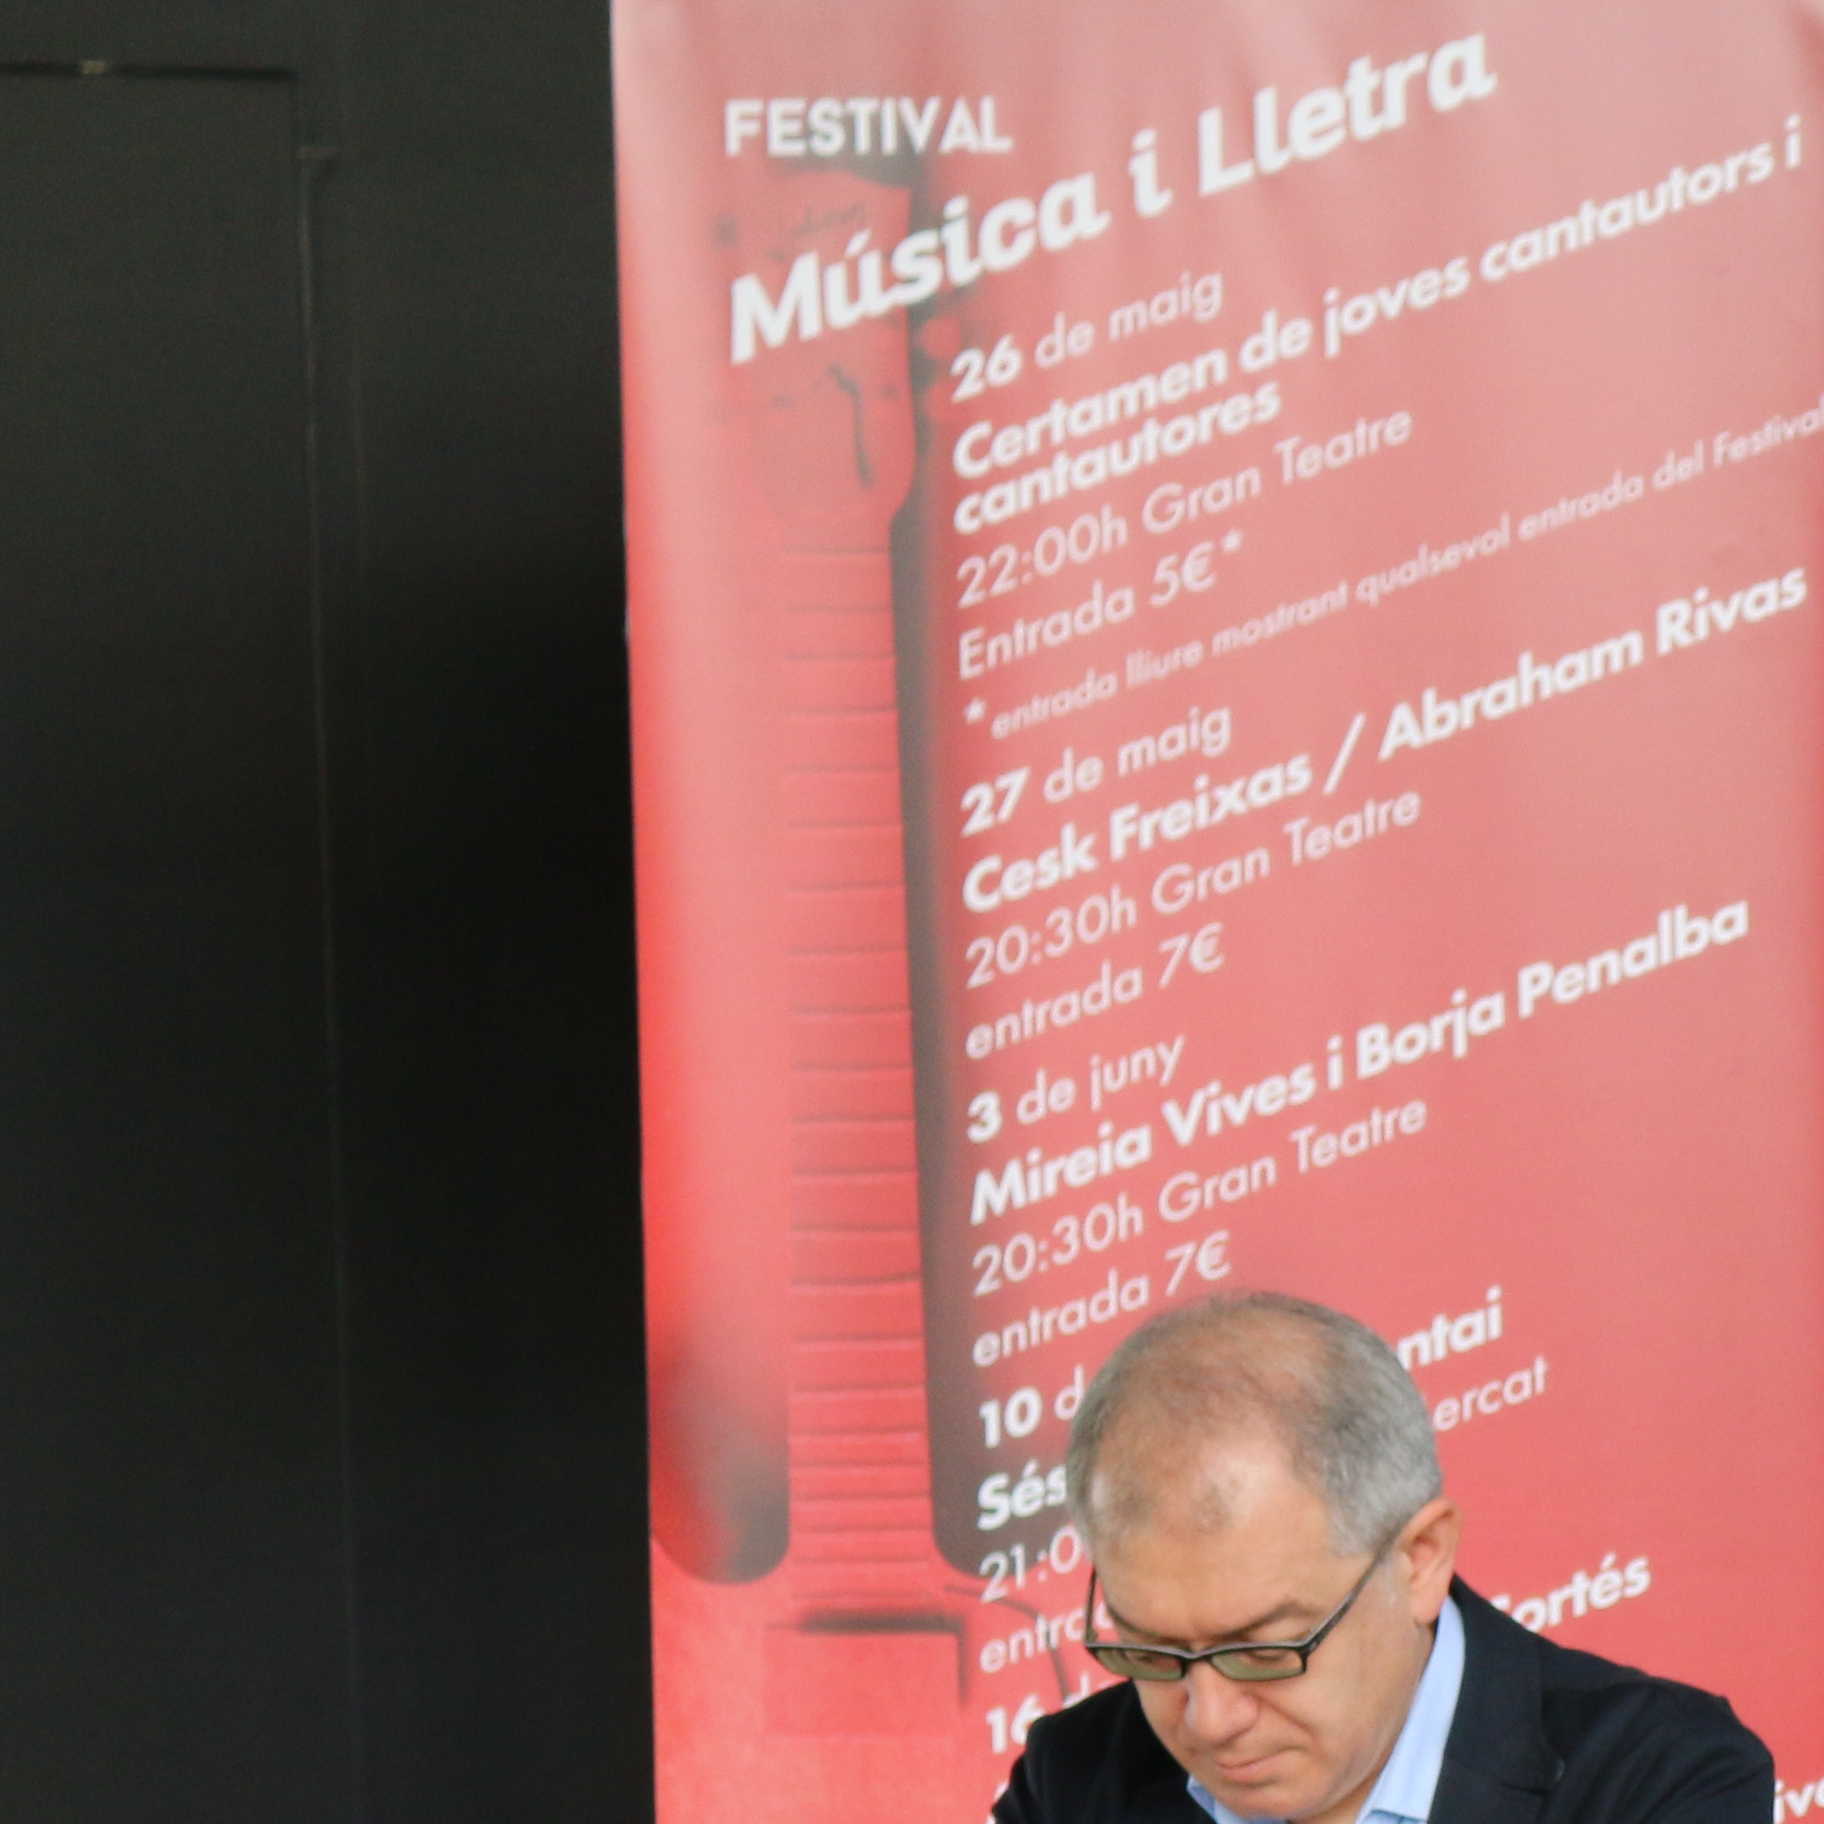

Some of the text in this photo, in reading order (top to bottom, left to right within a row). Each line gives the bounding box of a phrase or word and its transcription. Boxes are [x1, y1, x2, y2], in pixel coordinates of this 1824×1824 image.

[724, 96, 1014, 157] FESTIVAL
[730, 33, 1498, 364] Música i Lletra
[949, 272, 1224, 403] 26 de maig
[952, 113, 1802, 479] Certamen de joves cantautors i
[954, 381, 1281, 534] cantautores
[955, 410, 1413, 609] 22:00h Gran Teatre
[957, 579, 1135, 681] Entrada
[1125, 640, 1203, 688] lliure
[1211, 583, 1348, 657] mostrant
[1355, 513, 1510, 608] qualsevol
[1518, 470, 1644, 542] entrada
[1651, 440, 1703, 490] del
[960, 706, 1232, 838] 27 de maig
[961, 567, 1808, 914] Cesk Freixas / Abraham Rivas
[964, 791, 1421, 990] 20:30h Gran Teatre
[965, 921, 1225, 1060] entrada 7€
[966, 1035, 1186, 1143] 3 de juny
[970, 898, 1750, 1227] Mireia Vives i Borja Penalba
[971, 1100, 1428, 1297] 20:30h Gran Teatre
[972, 1229, 1232, 1369] entrada 7€
[1397, 1283, 1504, 1372] ntai
[979, 1363, 1085, 1449] 10 d
[1432, 1355, 1549, 1432] ercat
